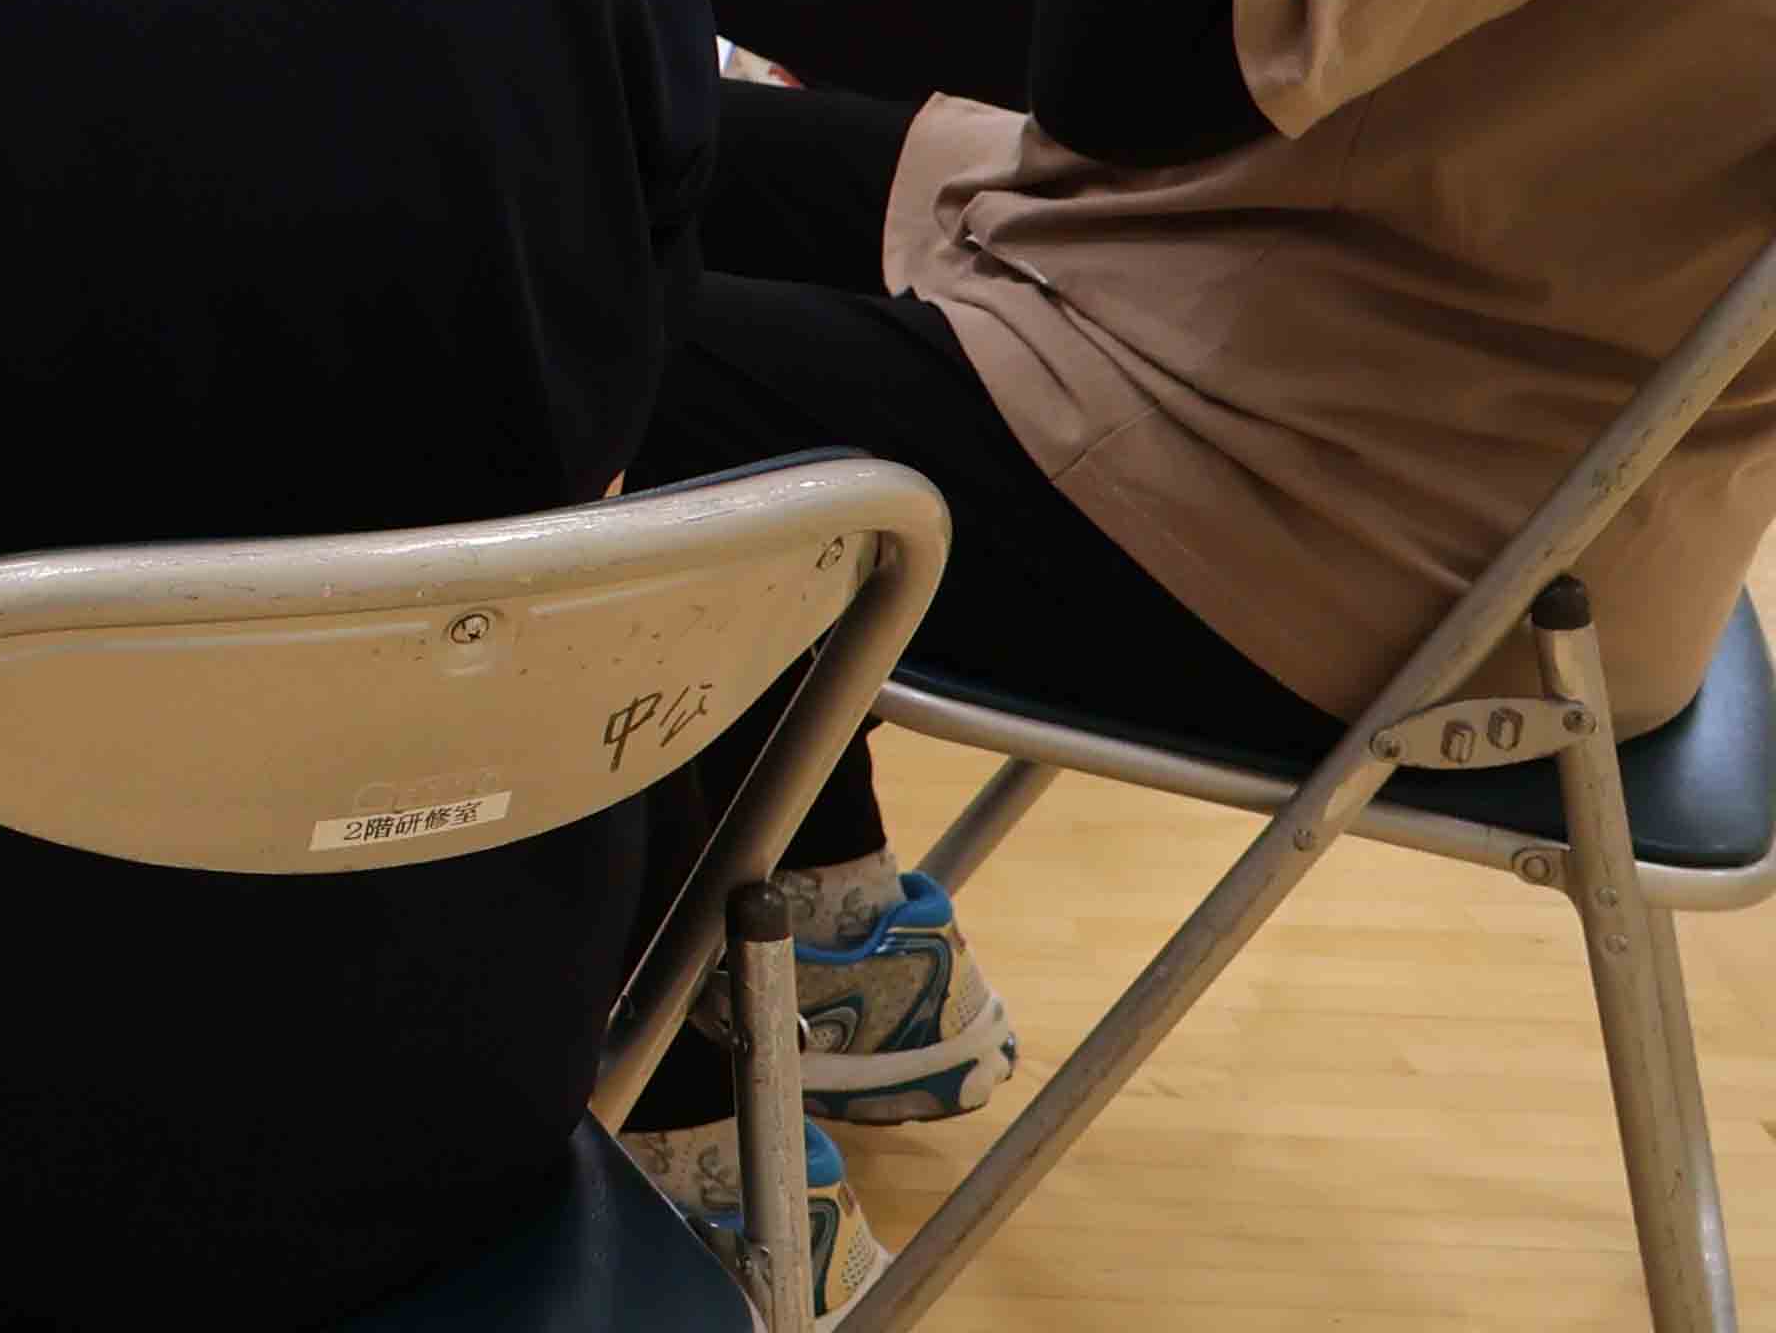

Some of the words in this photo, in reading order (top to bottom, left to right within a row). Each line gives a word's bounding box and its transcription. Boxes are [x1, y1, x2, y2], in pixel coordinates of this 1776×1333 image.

[603, 682, 715, 772] 中公
[342, 800, 483, 842] 2階研修室
